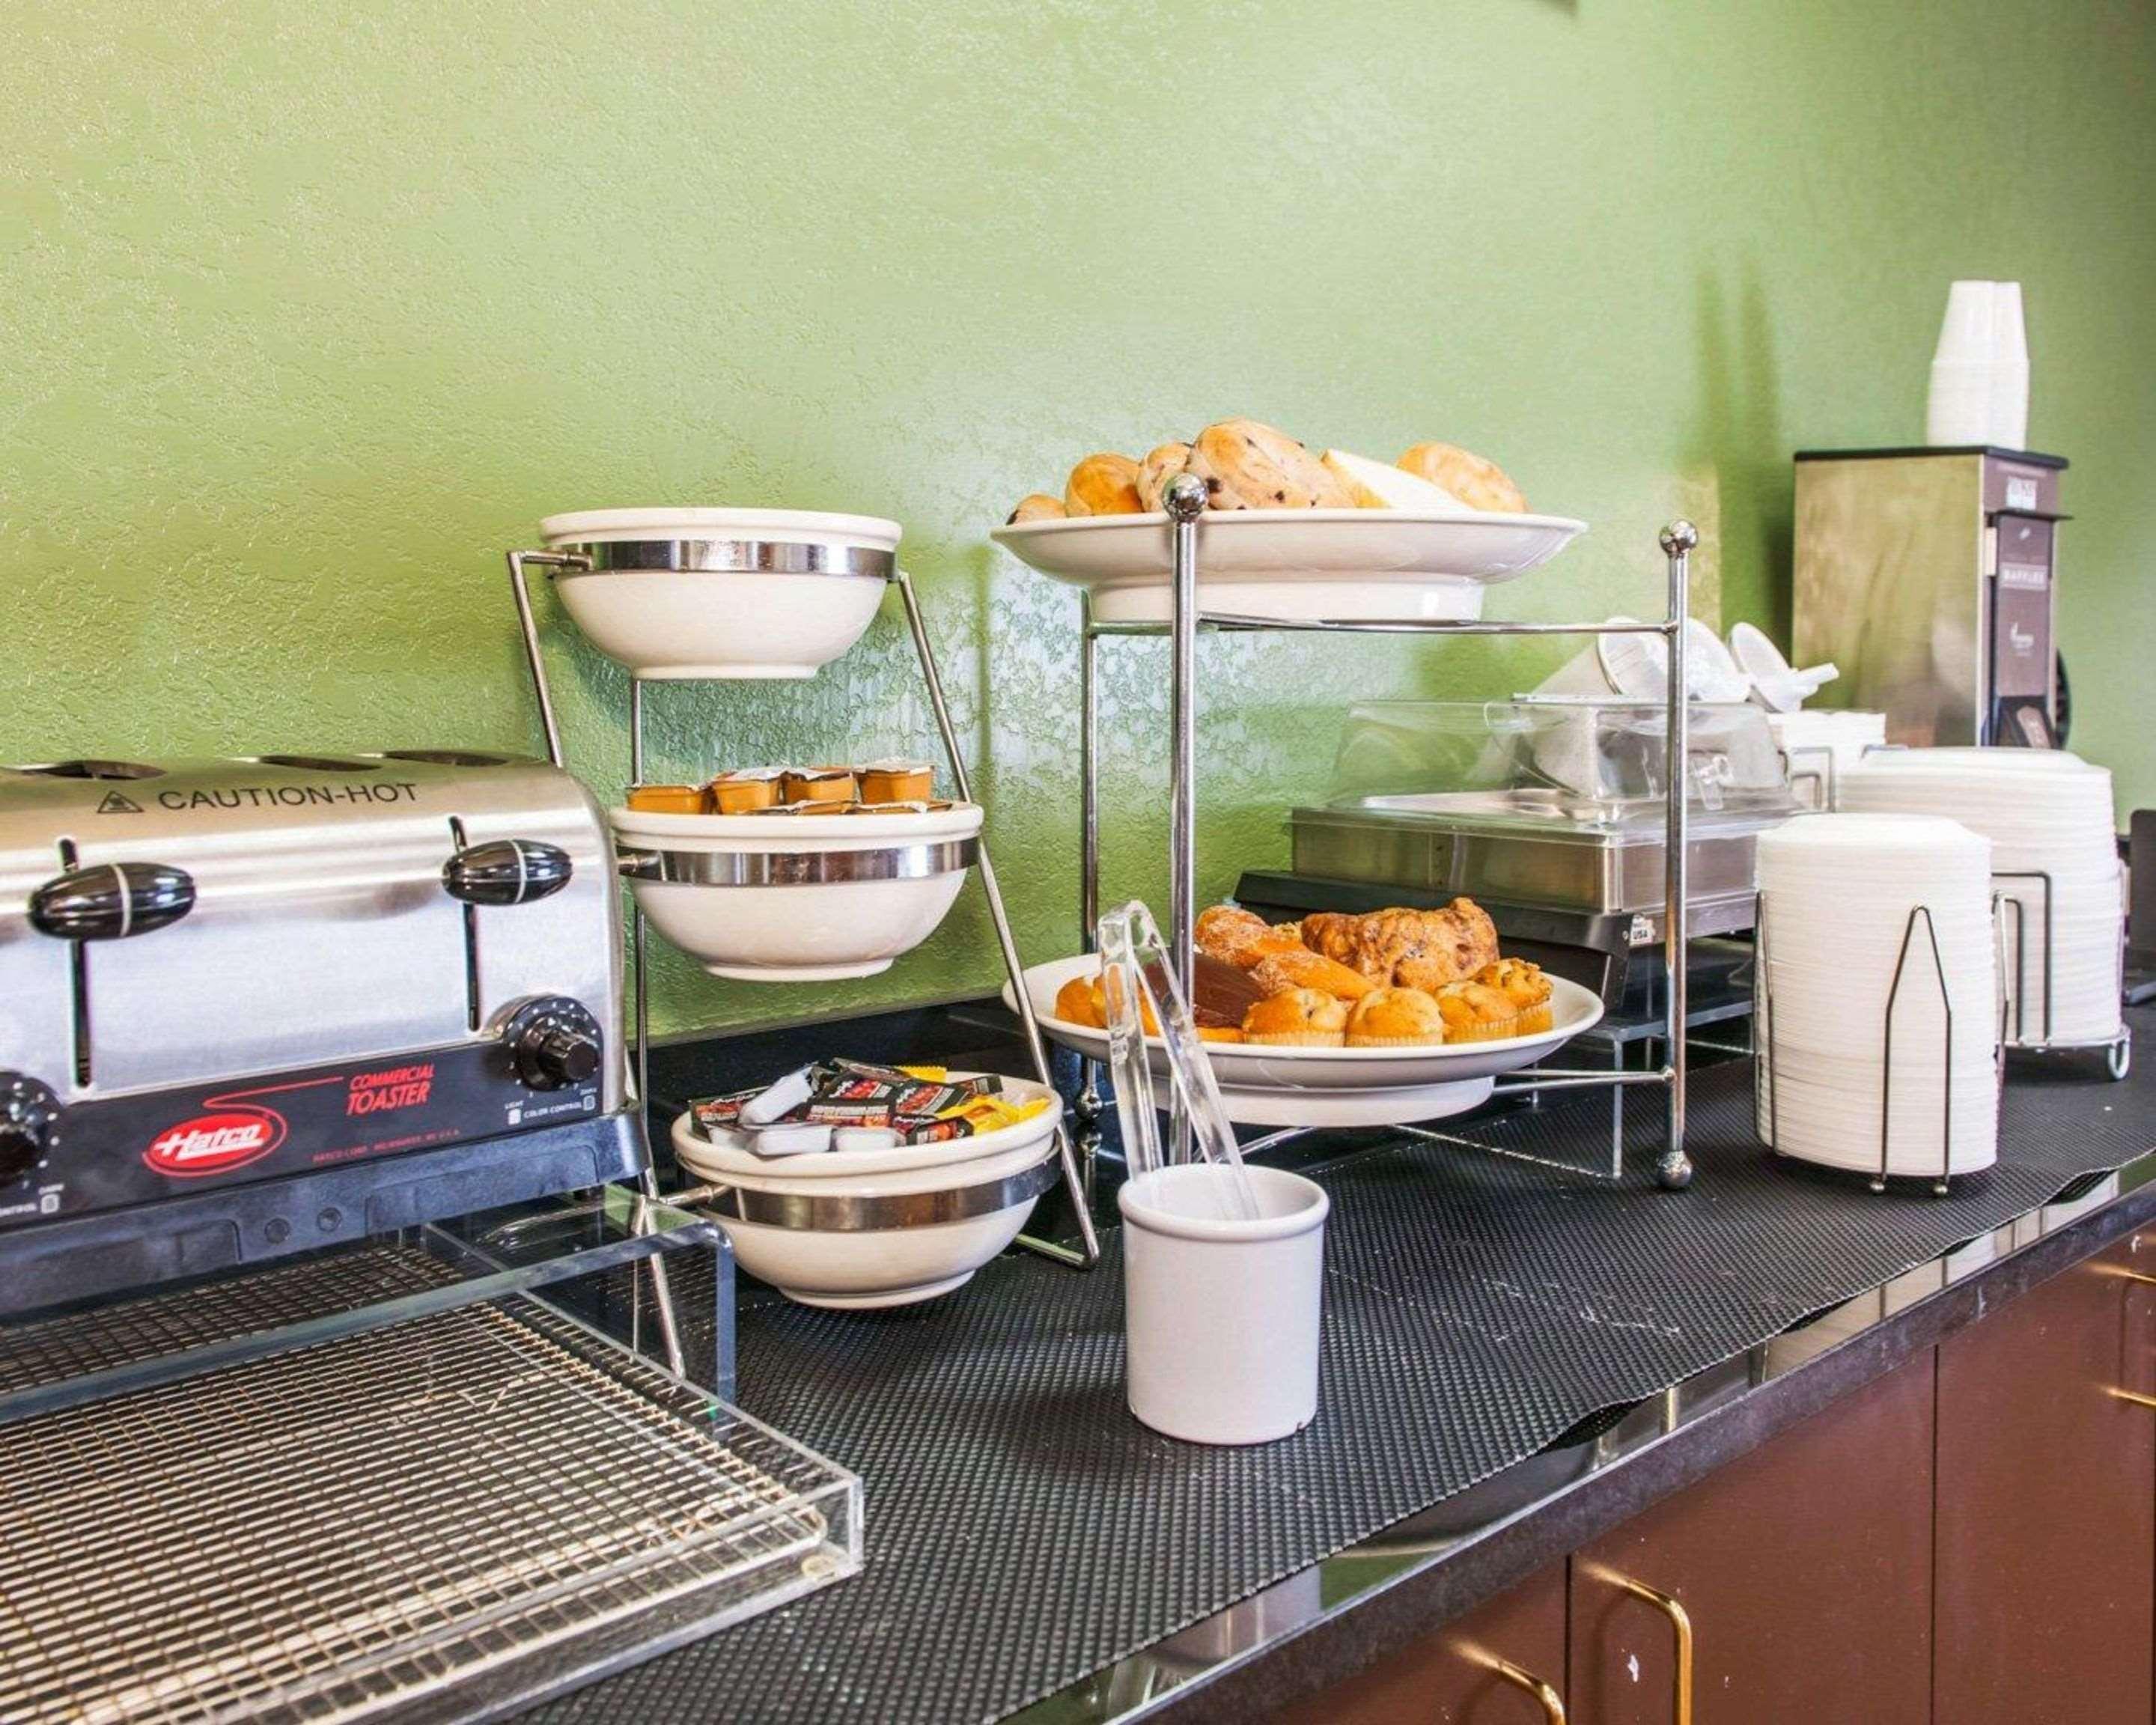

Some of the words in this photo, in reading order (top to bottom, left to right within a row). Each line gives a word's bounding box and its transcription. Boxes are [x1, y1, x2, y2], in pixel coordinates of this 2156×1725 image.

[158, 782, 416, 809] CAUTION-HOT
[350, 1064, 435, 1092] COMMERCIAL
[347, 1083, 430, 1116] TOASTER
[549, 1101, 582, 1113] CONTROL
[154, 1124, 264, 1161] Hatco
